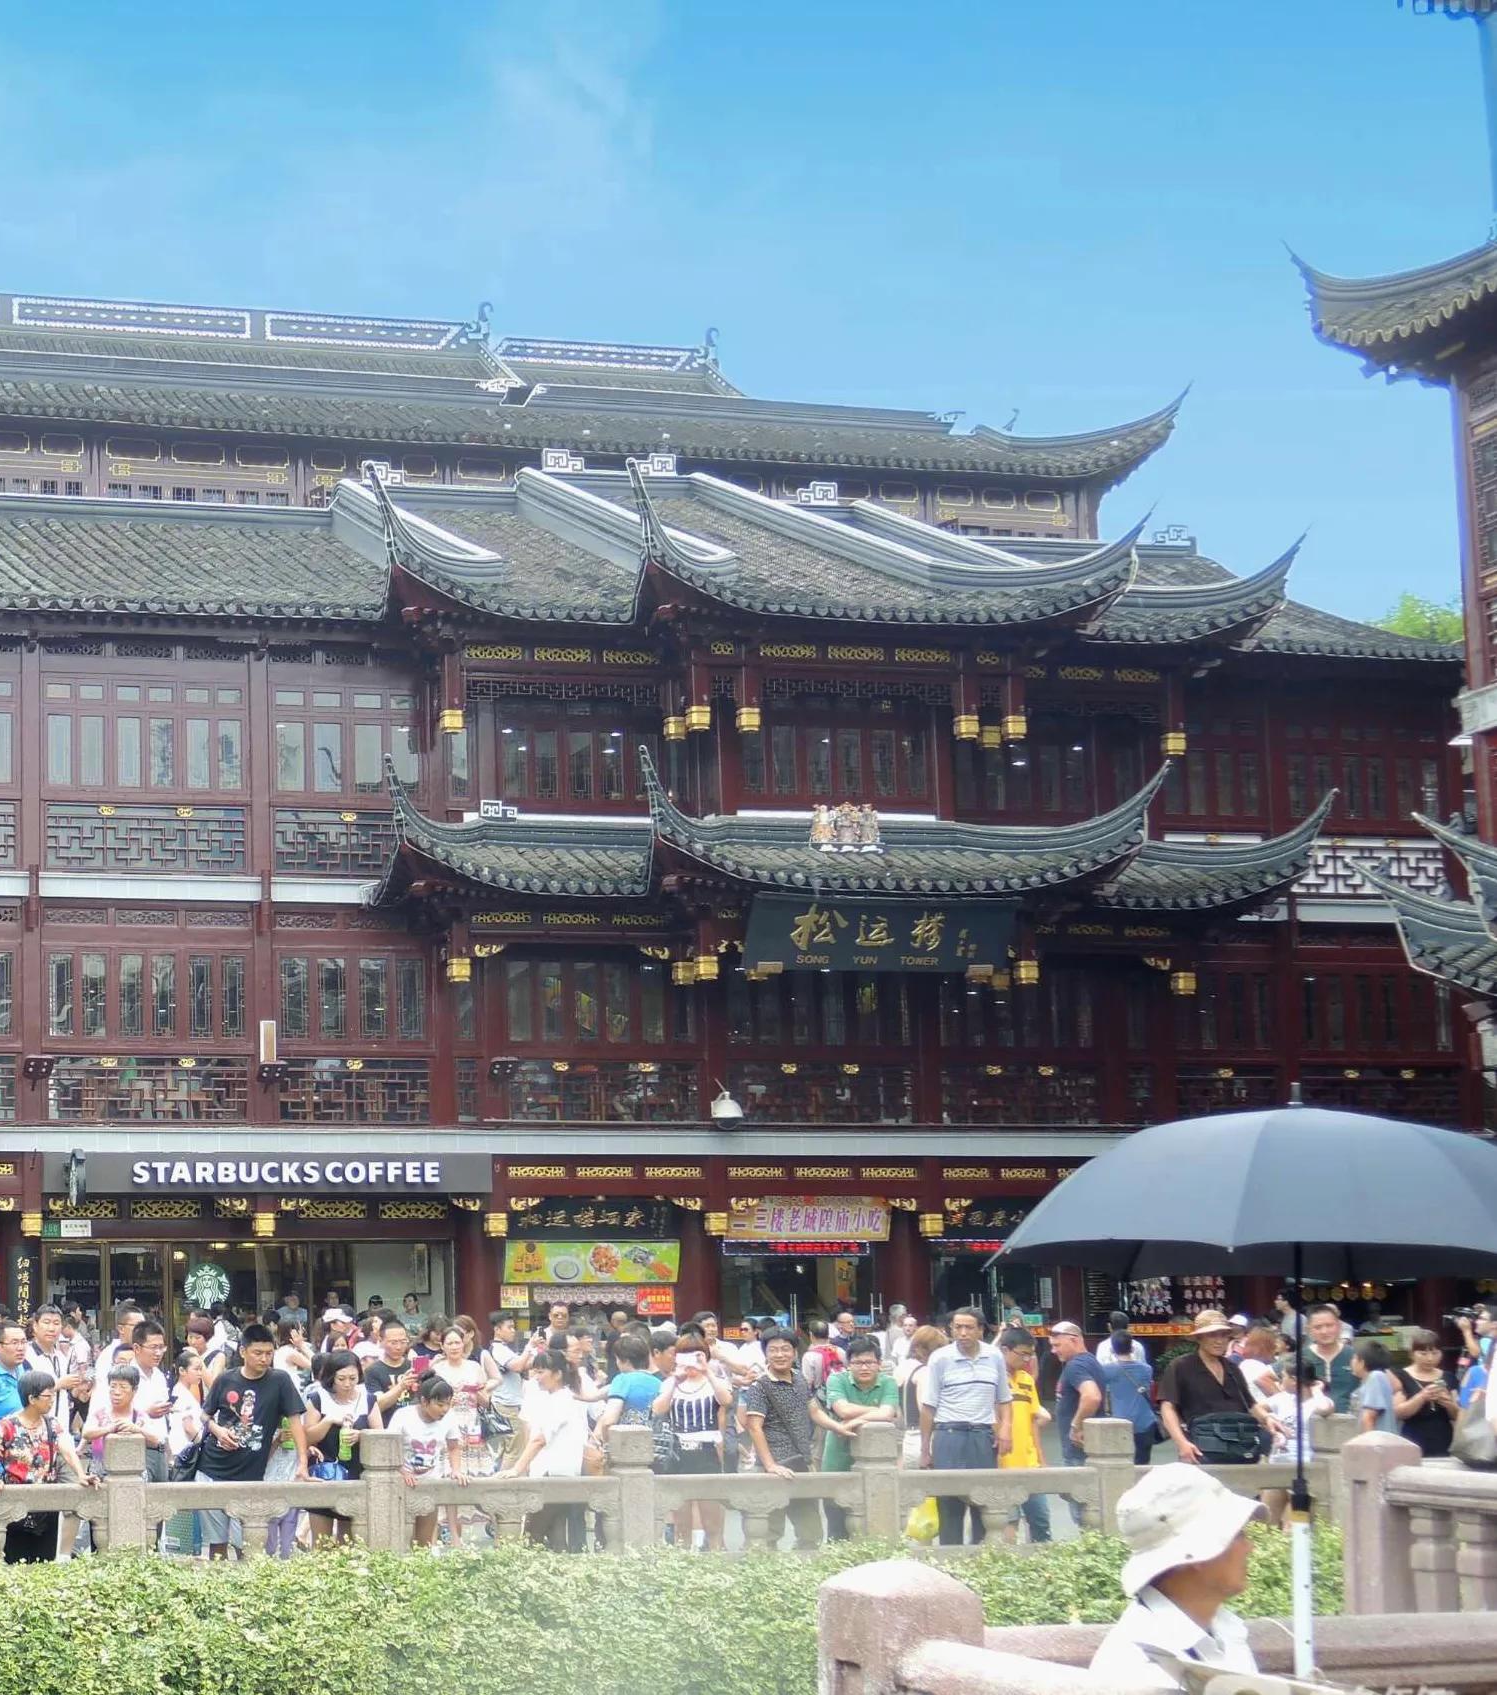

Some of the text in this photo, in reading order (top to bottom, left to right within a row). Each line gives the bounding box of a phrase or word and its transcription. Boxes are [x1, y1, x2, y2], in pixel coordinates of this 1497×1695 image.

[796, 955, 939, 967] SONG YUN TOWER
[132, 1161, 440, 1184] STARBUCKS COFFEE
